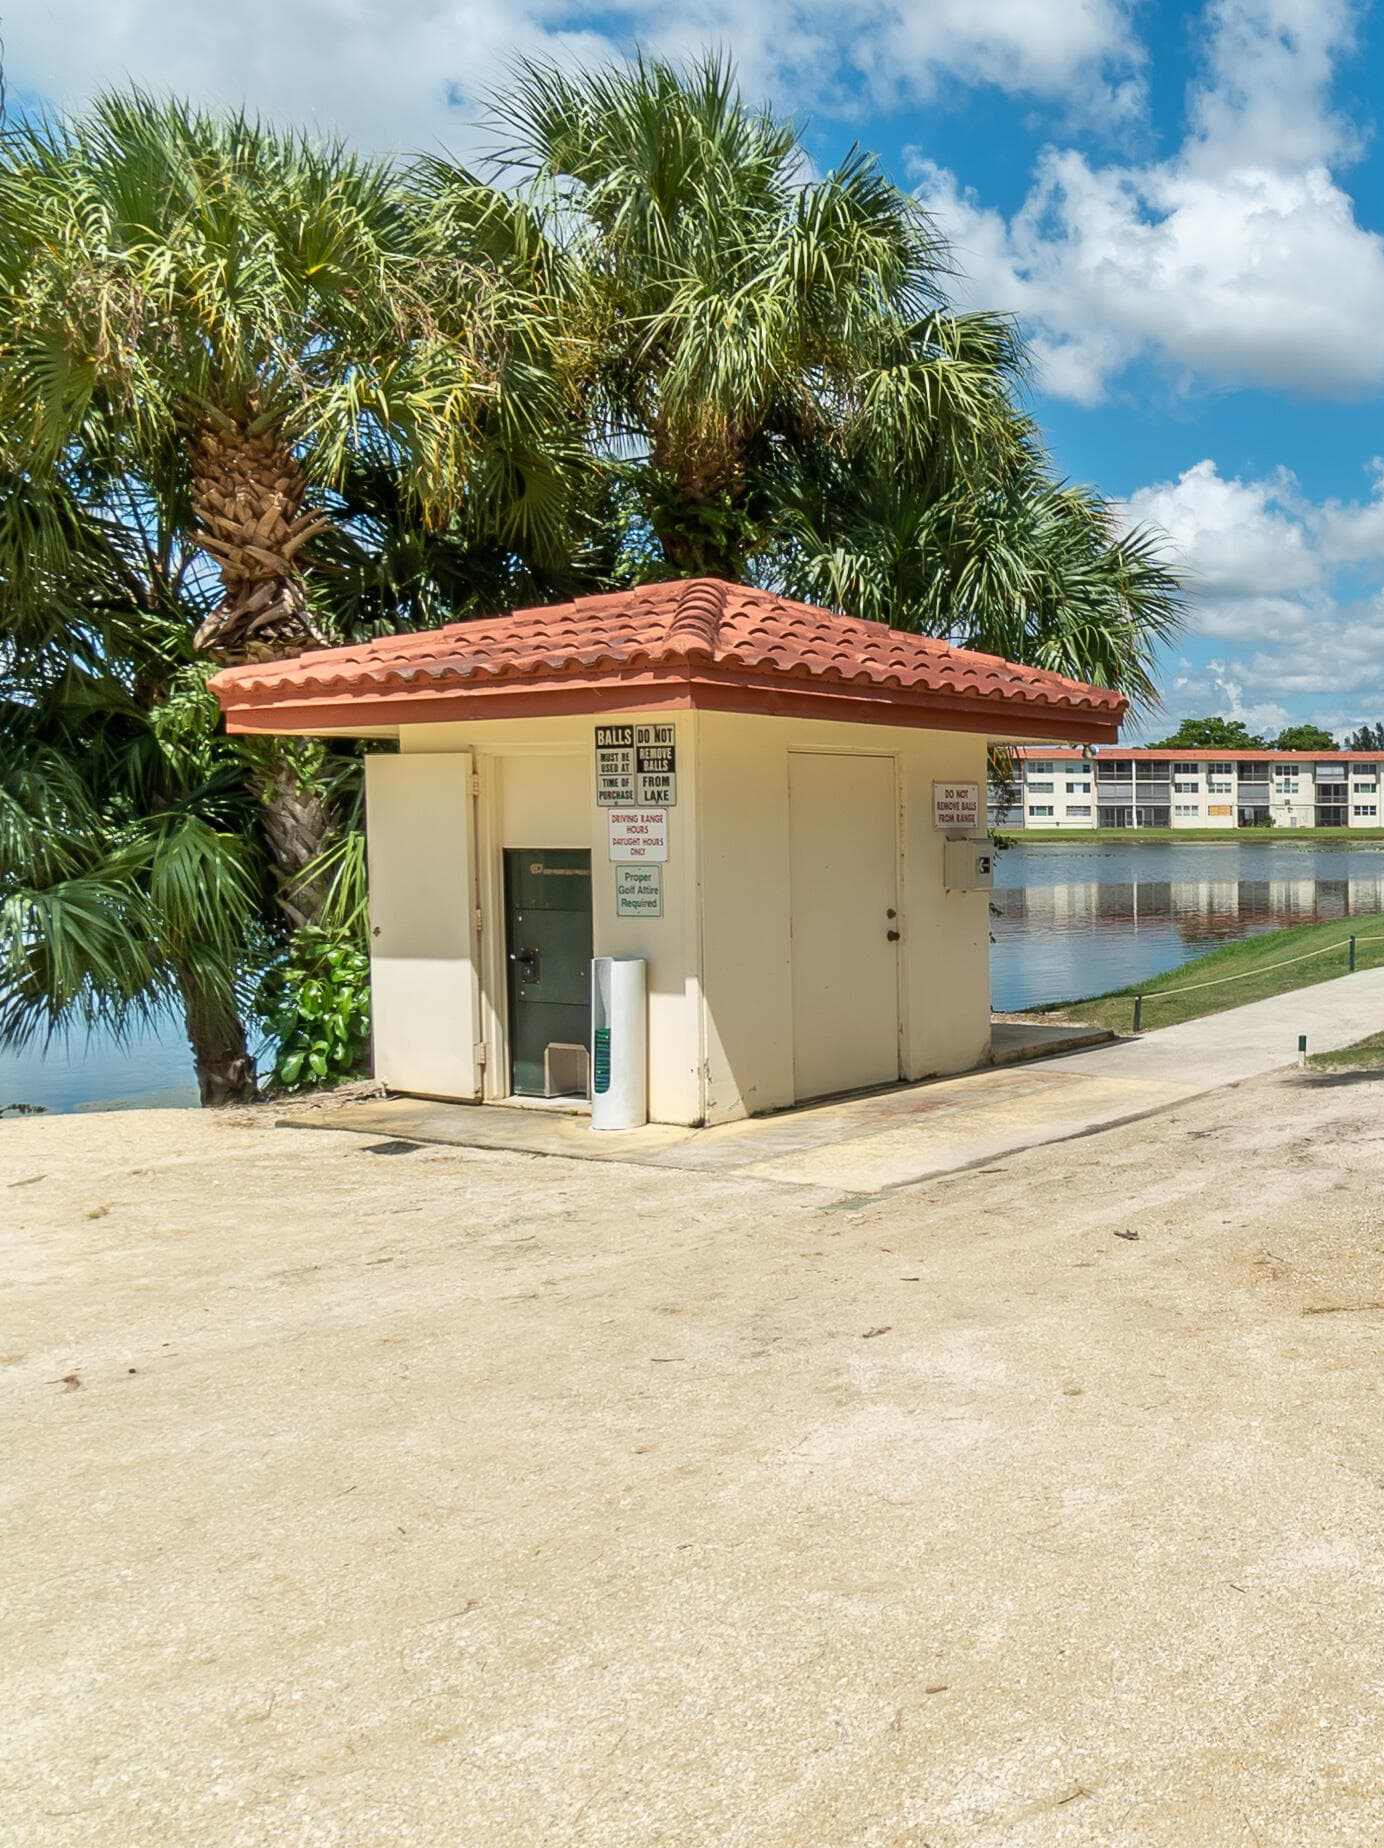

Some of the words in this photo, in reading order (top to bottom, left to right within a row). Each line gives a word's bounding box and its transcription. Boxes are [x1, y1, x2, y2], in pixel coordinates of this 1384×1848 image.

[597, 728, 632, 746] BALLS
[637, 729, 650, 744] DO
[654, 728, 673, 743] NOT
[600, 752, 619, 762] MUST
[622, 752, 630, 762] BE
[639, 747, 672, 760] REMOVE
[601, 763, 619, 773] USED
[621, 763, 630, 773] AT
[643, 760, 669, 771] BALLS
[602, 778, 619, 788] TIME
[621, 778, 630, 787] OF
[642, 776, 670, 787] FROM
[599, 790, 633, 800] PURCHASE
[644, 790, 669, 801] LAKE
[944, 789, 955, 799] DO
[956, 789, 969, 799] NOT
[937, 802, 960, 811] REMOVE
[961, 802, 977, 811] BALLS
[611, 814, 639, 824] DRIVING
[640, 814, 664, 824] RANGE
[938, 814, 955, 823] FROM
[956, 814, 976, 823] RANGE
[626, 825, 649, 834] HOURS
[612, 837, 641, 846] DAYLIGHT
[642, 838, 664, 846] HOURS
[629, 848, 646, 856] ONLY
[624, 872, 653, 883] Proper
[618, 885, 636, 895] Golf
[637, 885, 659, 895] Attire
[621, 898, 657, 910] Required
